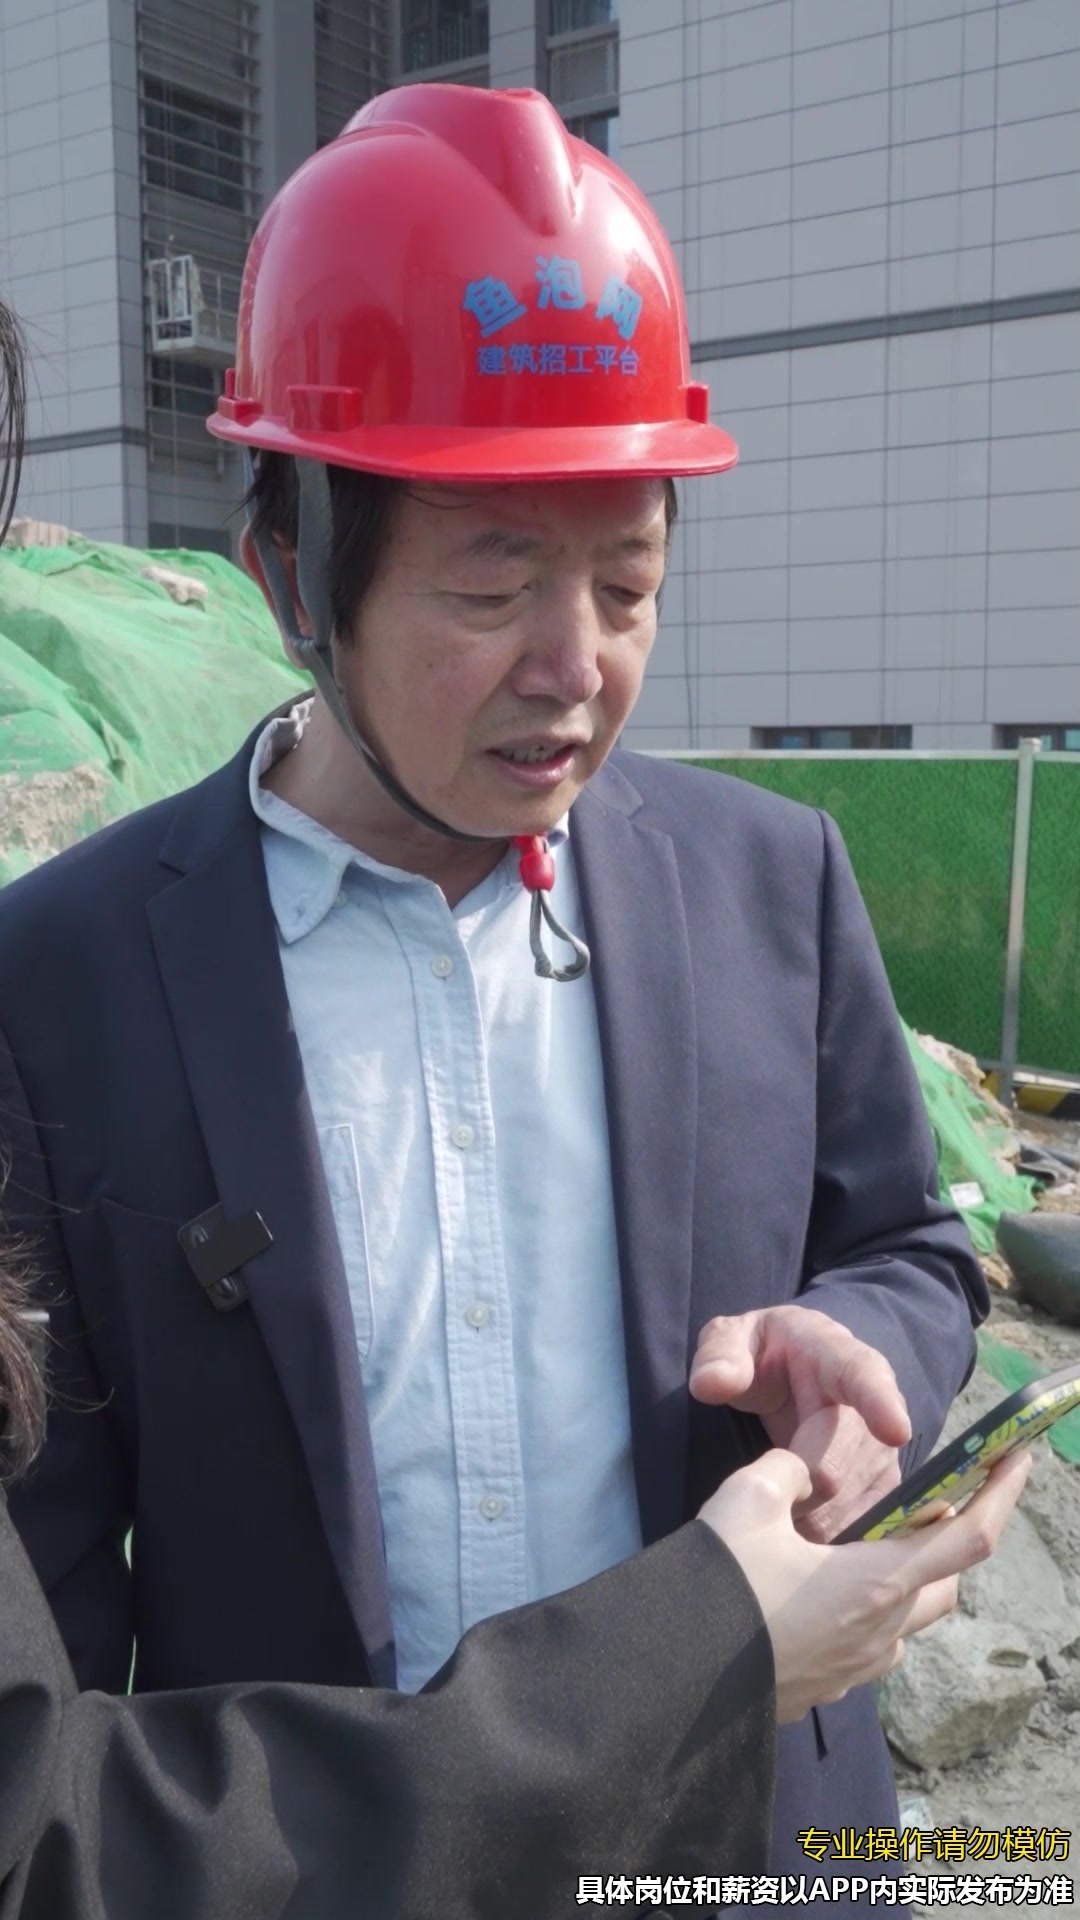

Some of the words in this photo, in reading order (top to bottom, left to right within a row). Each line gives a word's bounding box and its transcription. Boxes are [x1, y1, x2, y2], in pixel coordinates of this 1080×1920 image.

[463, 254, 644, 340] 鱼泡网
[478, 343, 640, 376] 建筑招工平台
